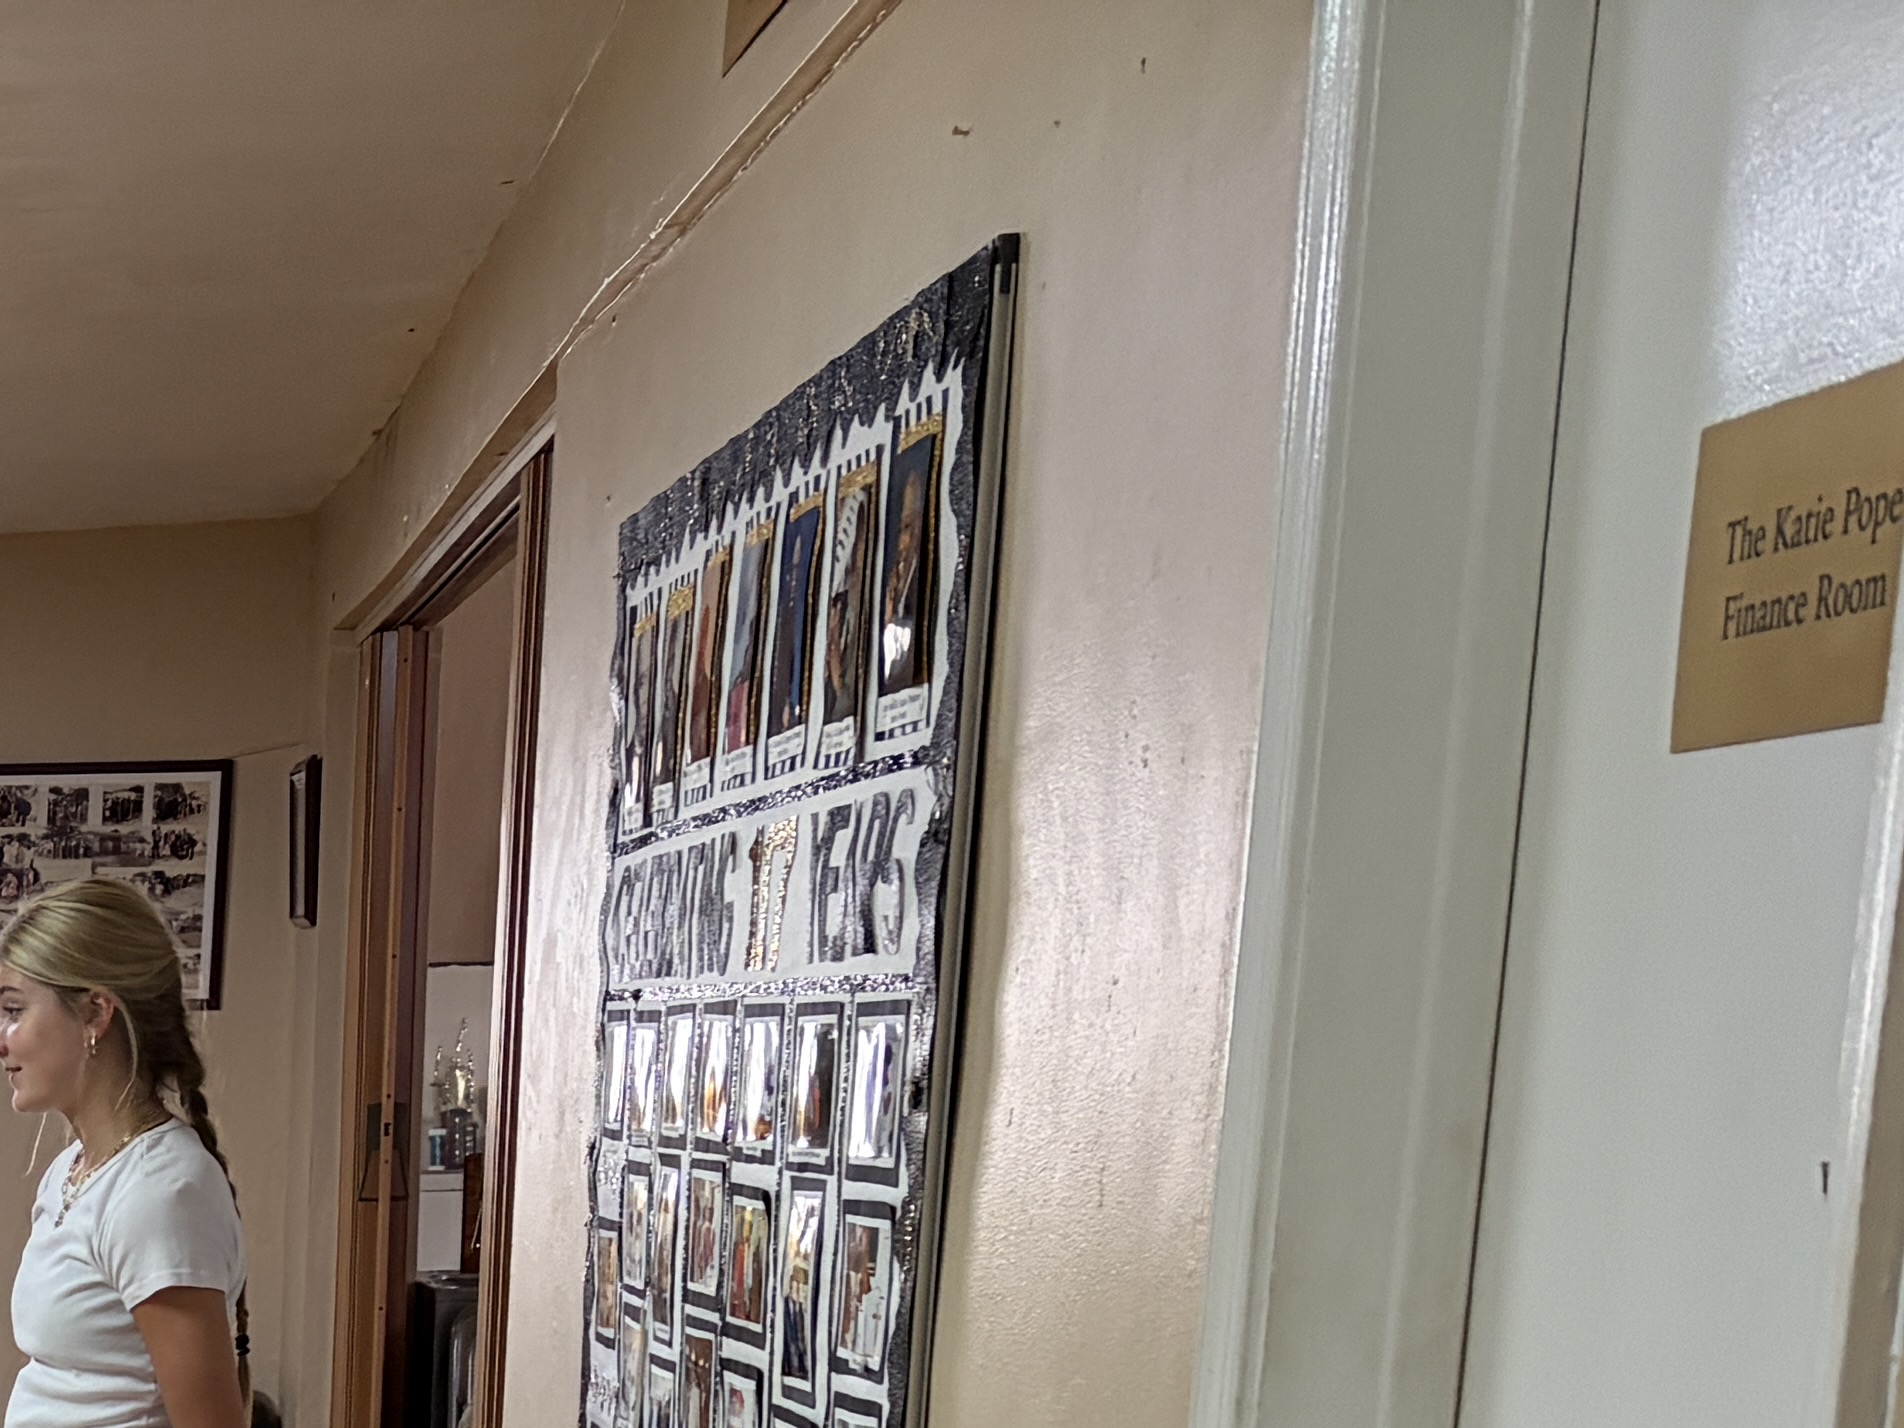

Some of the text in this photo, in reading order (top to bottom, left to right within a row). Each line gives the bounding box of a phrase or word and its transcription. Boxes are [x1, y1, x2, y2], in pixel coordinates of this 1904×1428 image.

[1726, 486, 1904, 566] The Katie Pope
[1721, 572, 1887, 641] Finance Room
[806, 787, 916, 965] YEARS
